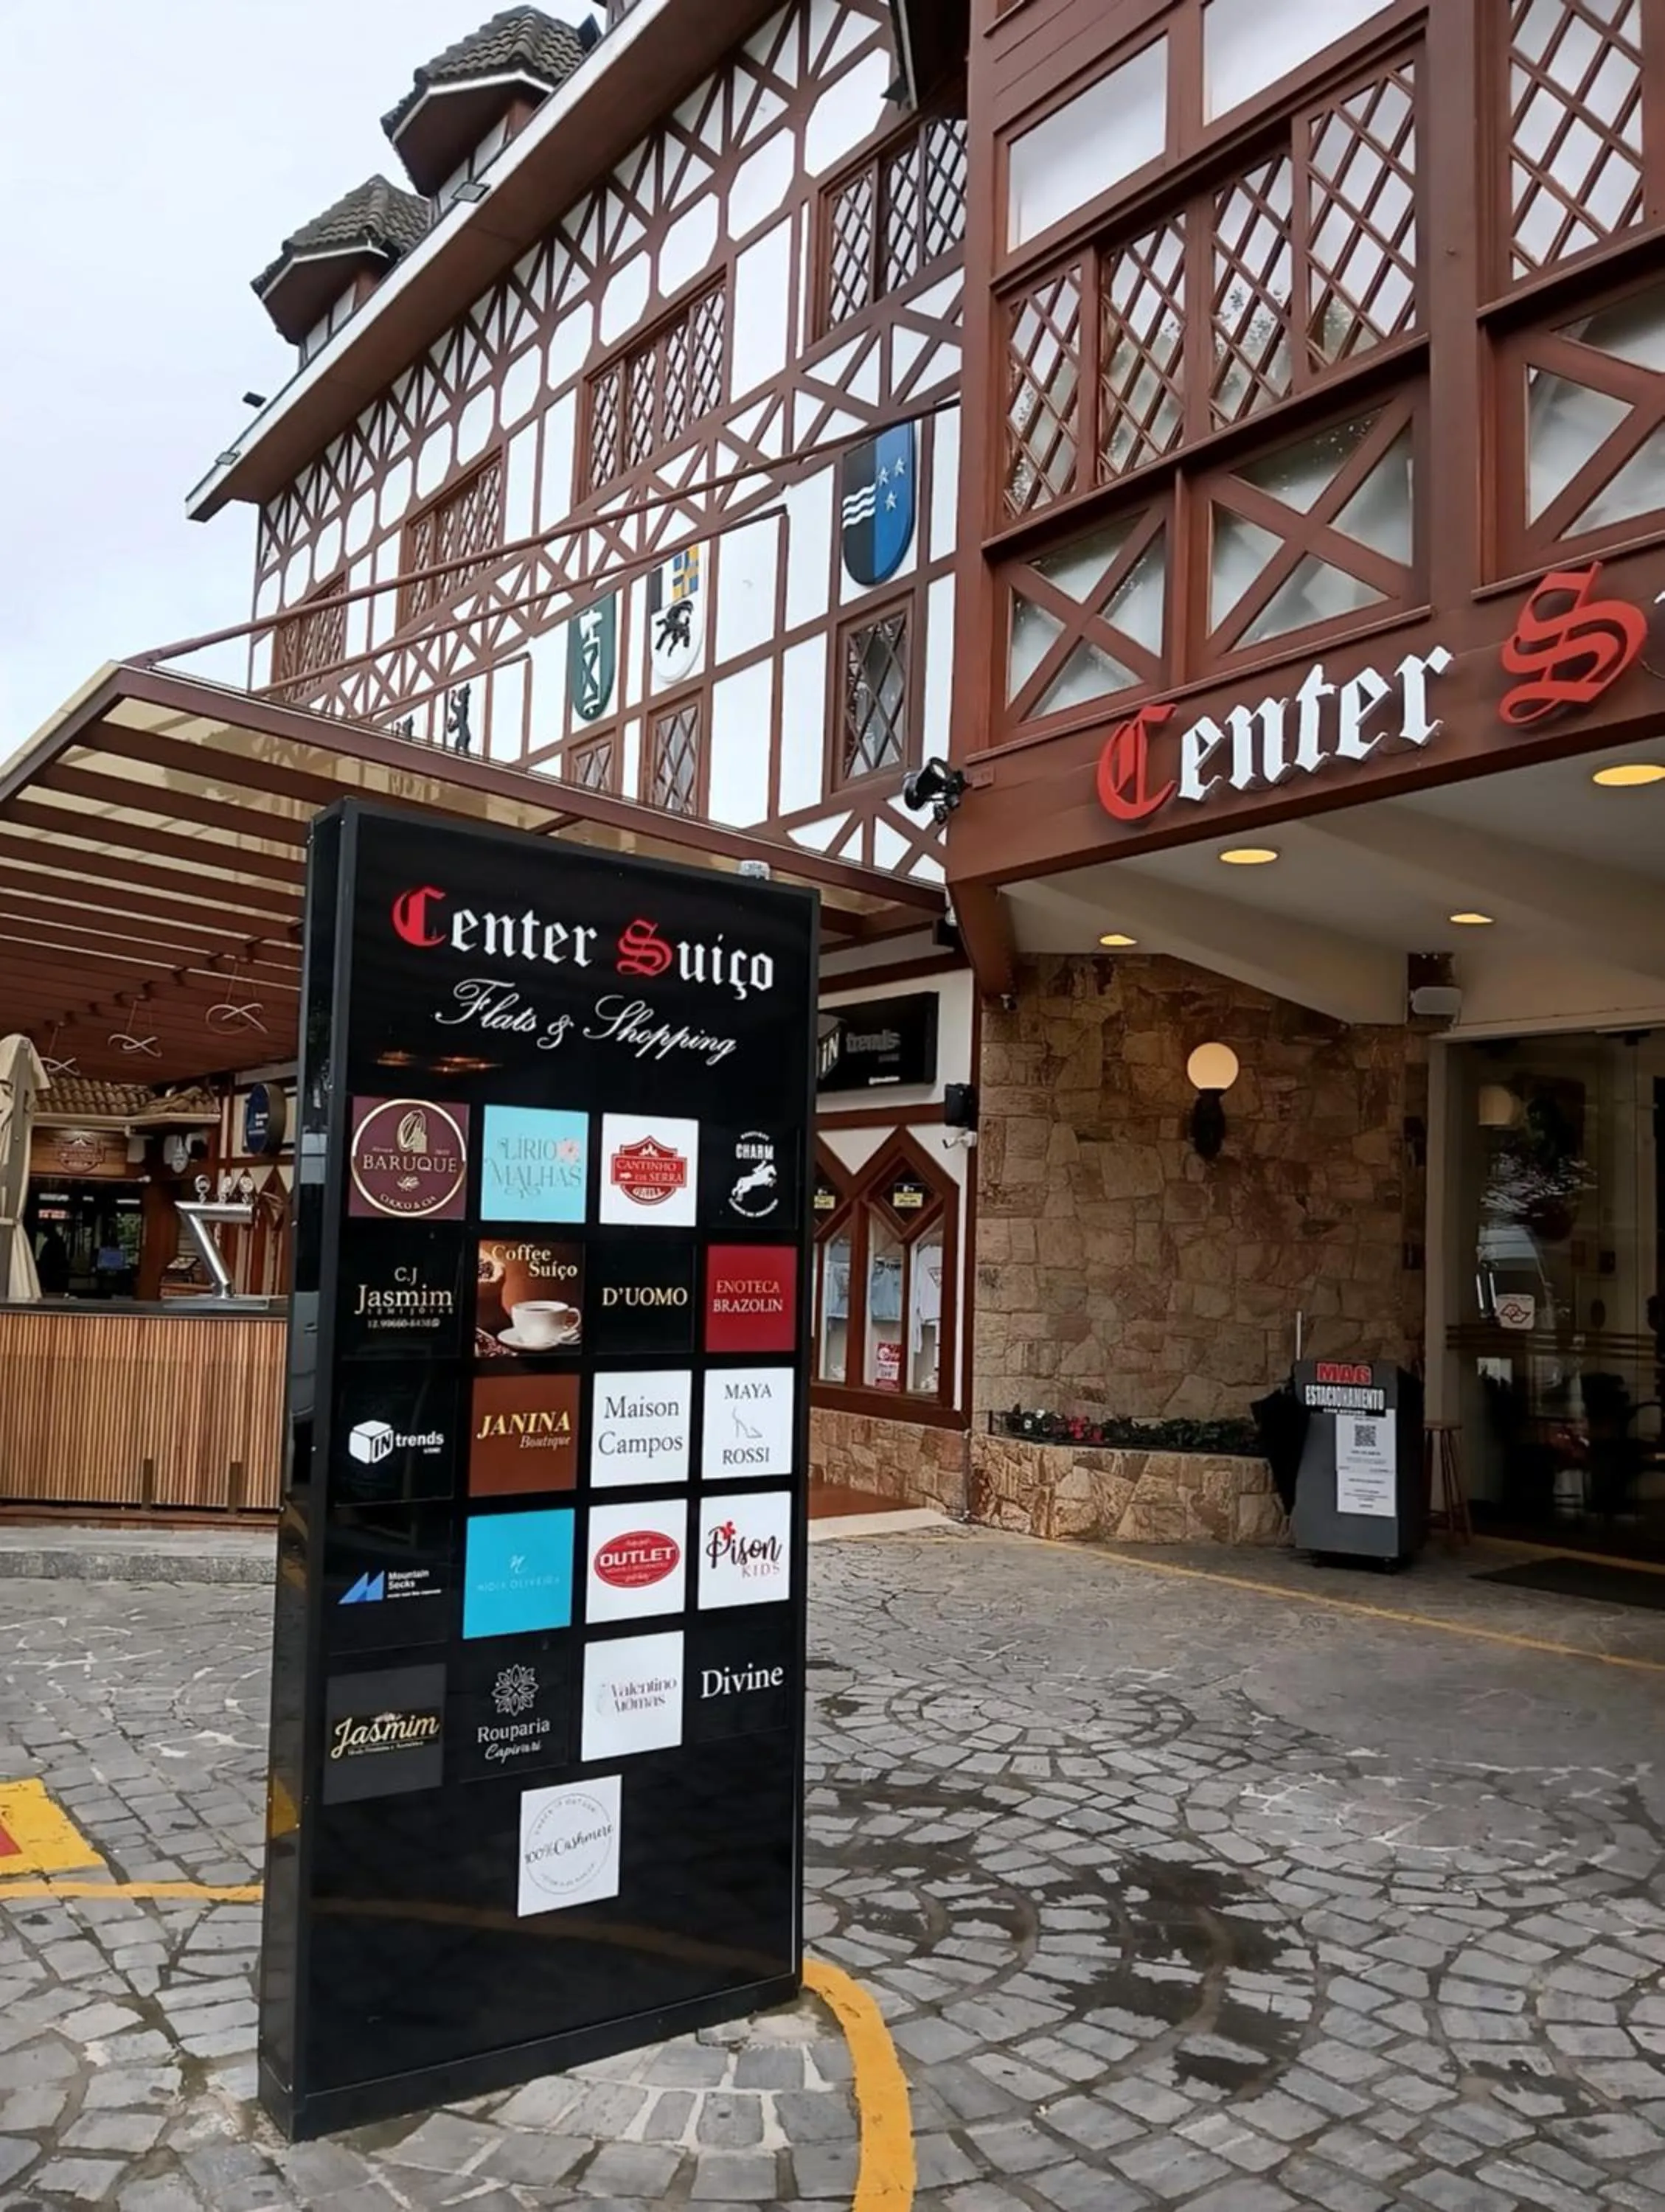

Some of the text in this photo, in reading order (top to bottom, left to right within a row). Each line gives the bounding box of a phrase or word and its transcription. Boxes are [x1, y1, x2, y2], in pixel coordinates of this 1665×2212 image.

[1096, 560, 1665, 822] Center S
[392, 886, 774, 1000] Center Suiço
[435, 978, 737, 1065] Flats & Shopping
[846, 1029, 901, 1053] trends
[363, 1154, 456, 1173] BARUQUE
[616, 1159, 677, 1172] CANTINHO
[649, 1172, 683, 1183] SERRA
[492, 1244, 552, 1262] Coffee
[602, 1287, 688, 1306] D'UOMO
[716, 1280, 780, 1295] ENOTECA
[354, 1283, 453, 1315] Jasmim
[713, 1298, 783, 1312] BRAZOLIN
[724, 1383, 773, 1400] MAYA
[604, 1396, 680, 1419] Maison
[477, 1411, 571, 1440] JANINA
[395, 1430, 444, 1447] trends
[520, 1435, 571, 1451] Boutique
[598, 1431, 684, 1458] Campos
[723, 1447, 770, 1465] ROSSI
[600, 1547, 676, 1568] OUTLET
[741, 1565, 780, 1579] KIDS
[611, 1677, 678, 1697] Valentino
[701, 1662, 783, 1699] Divine
[330, 1714, 440, 1759] Jasmim
[477, 1718, 550, 1743] Rouparia
